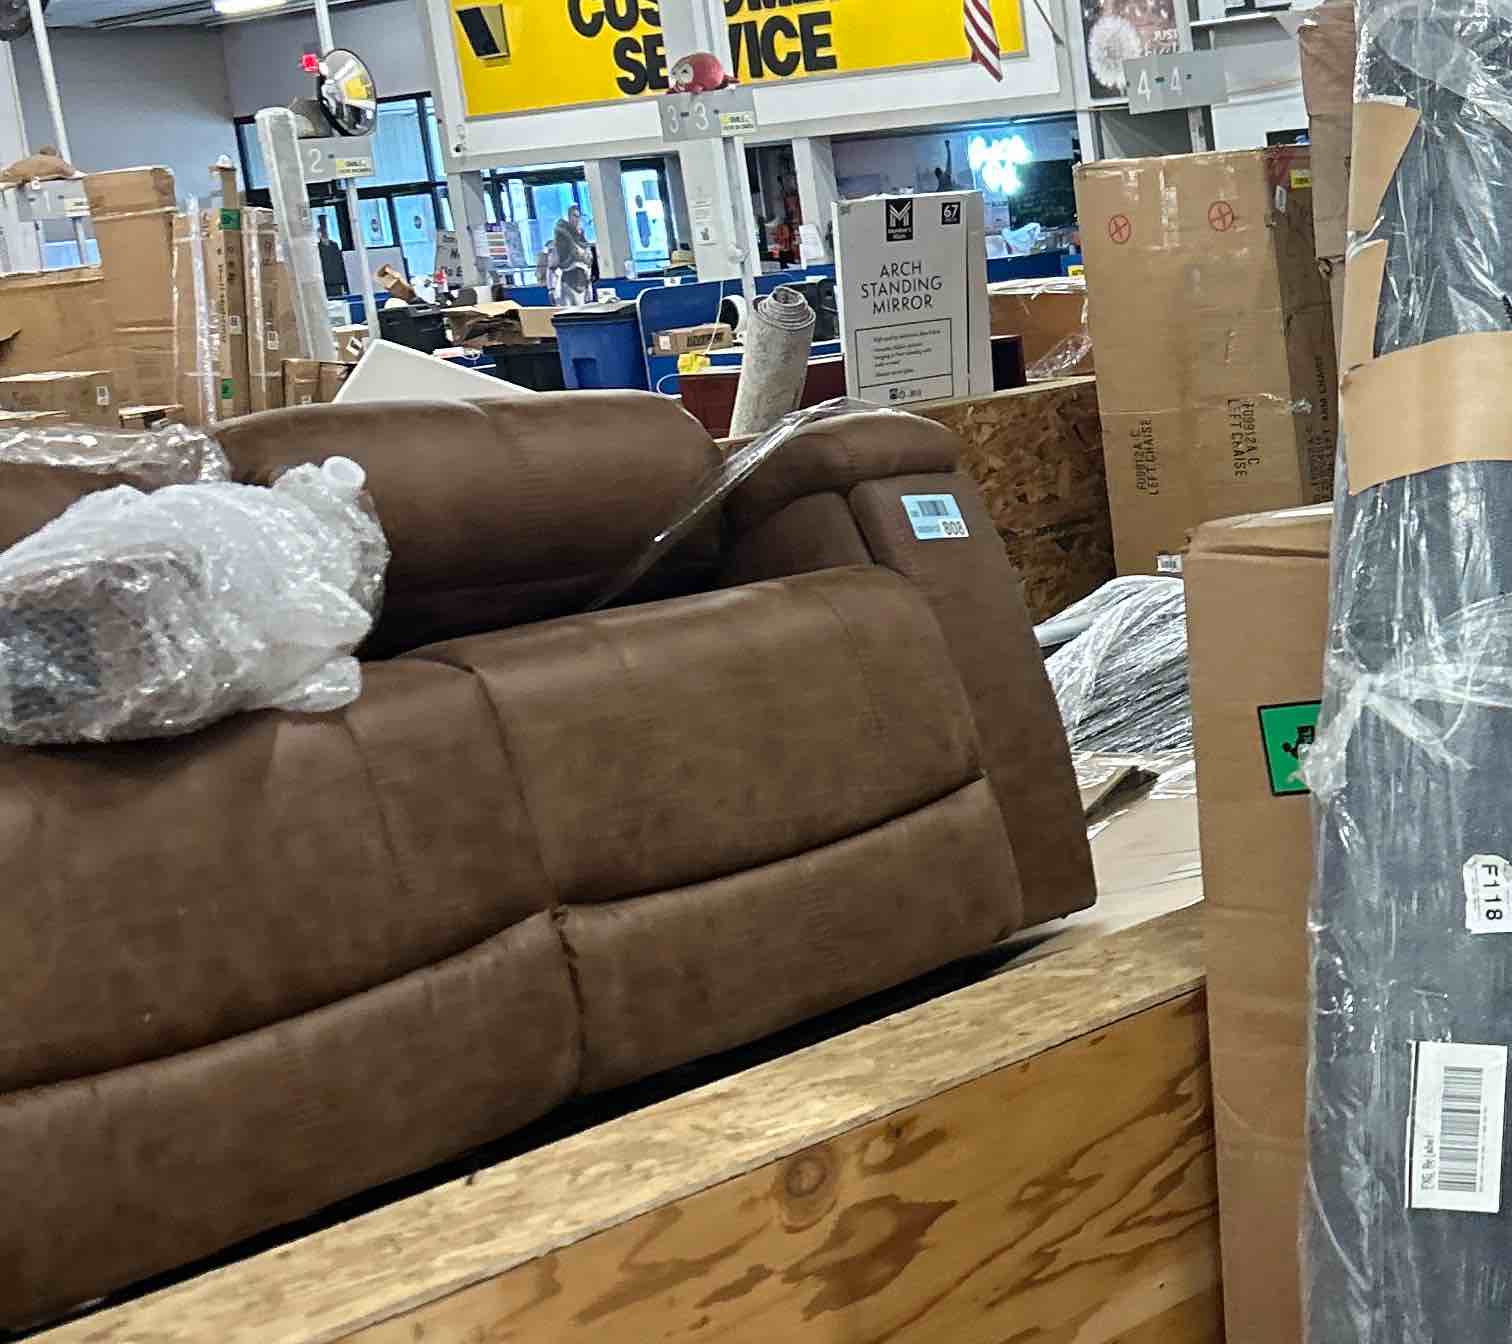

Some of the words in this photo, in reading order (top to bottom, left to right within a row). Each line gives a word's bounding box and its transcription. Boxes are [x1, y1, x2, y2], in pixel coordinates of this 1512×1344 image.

[880, 260, 922, 278] ARCH
[861, 275, 943, 298] STANDING
[873, 294, 933, 314] MIRROR
[1481, 864, 1504, 921] F118
